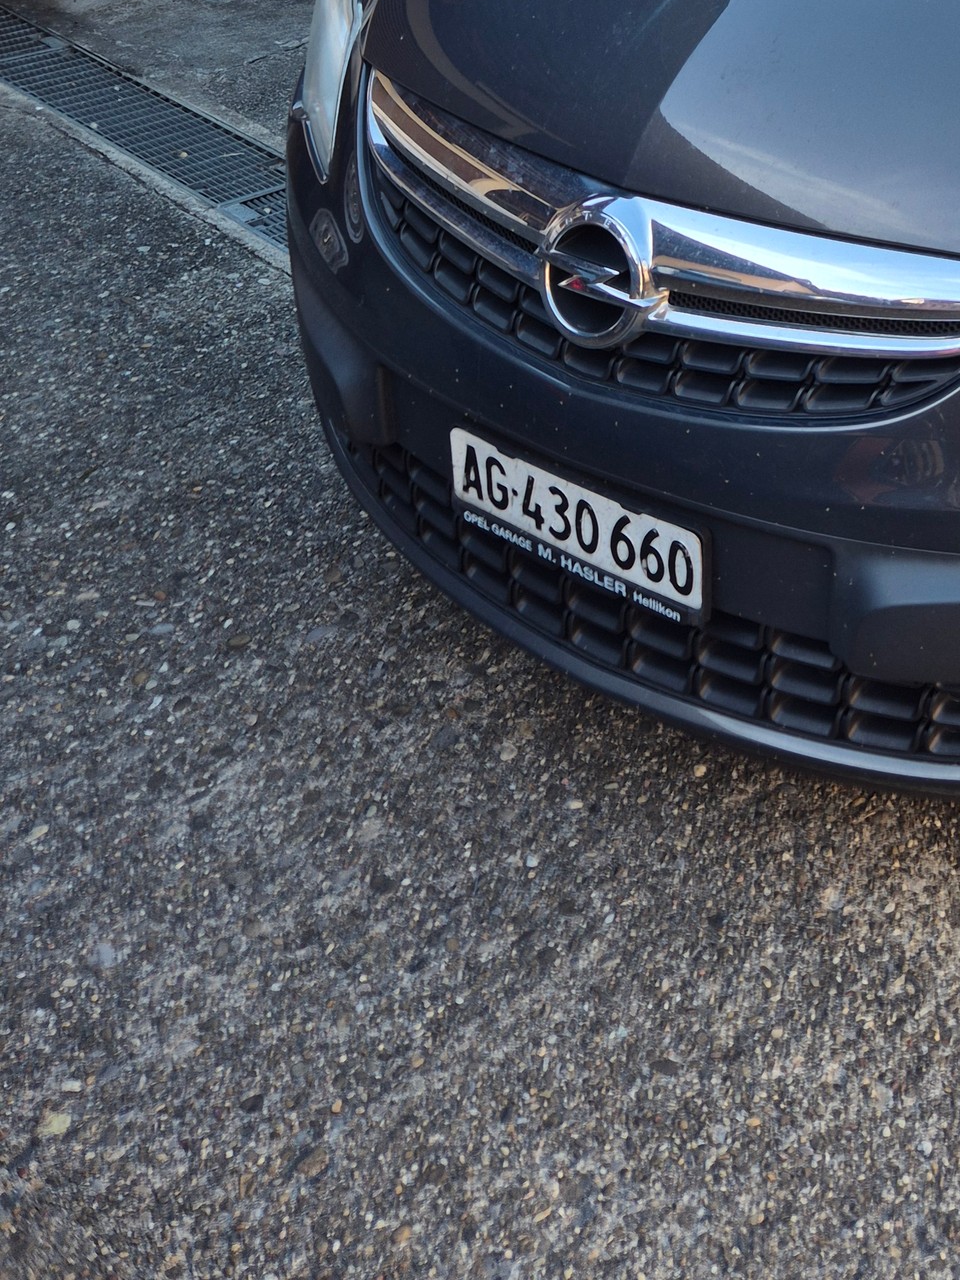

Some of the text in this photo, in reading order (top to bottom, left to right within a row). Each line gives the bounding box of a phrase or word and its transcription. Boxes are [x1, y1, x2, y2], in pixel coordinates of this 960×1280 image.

[463, 510, 682, 622] OPEL GARAGE M. HASLER Hellikon
